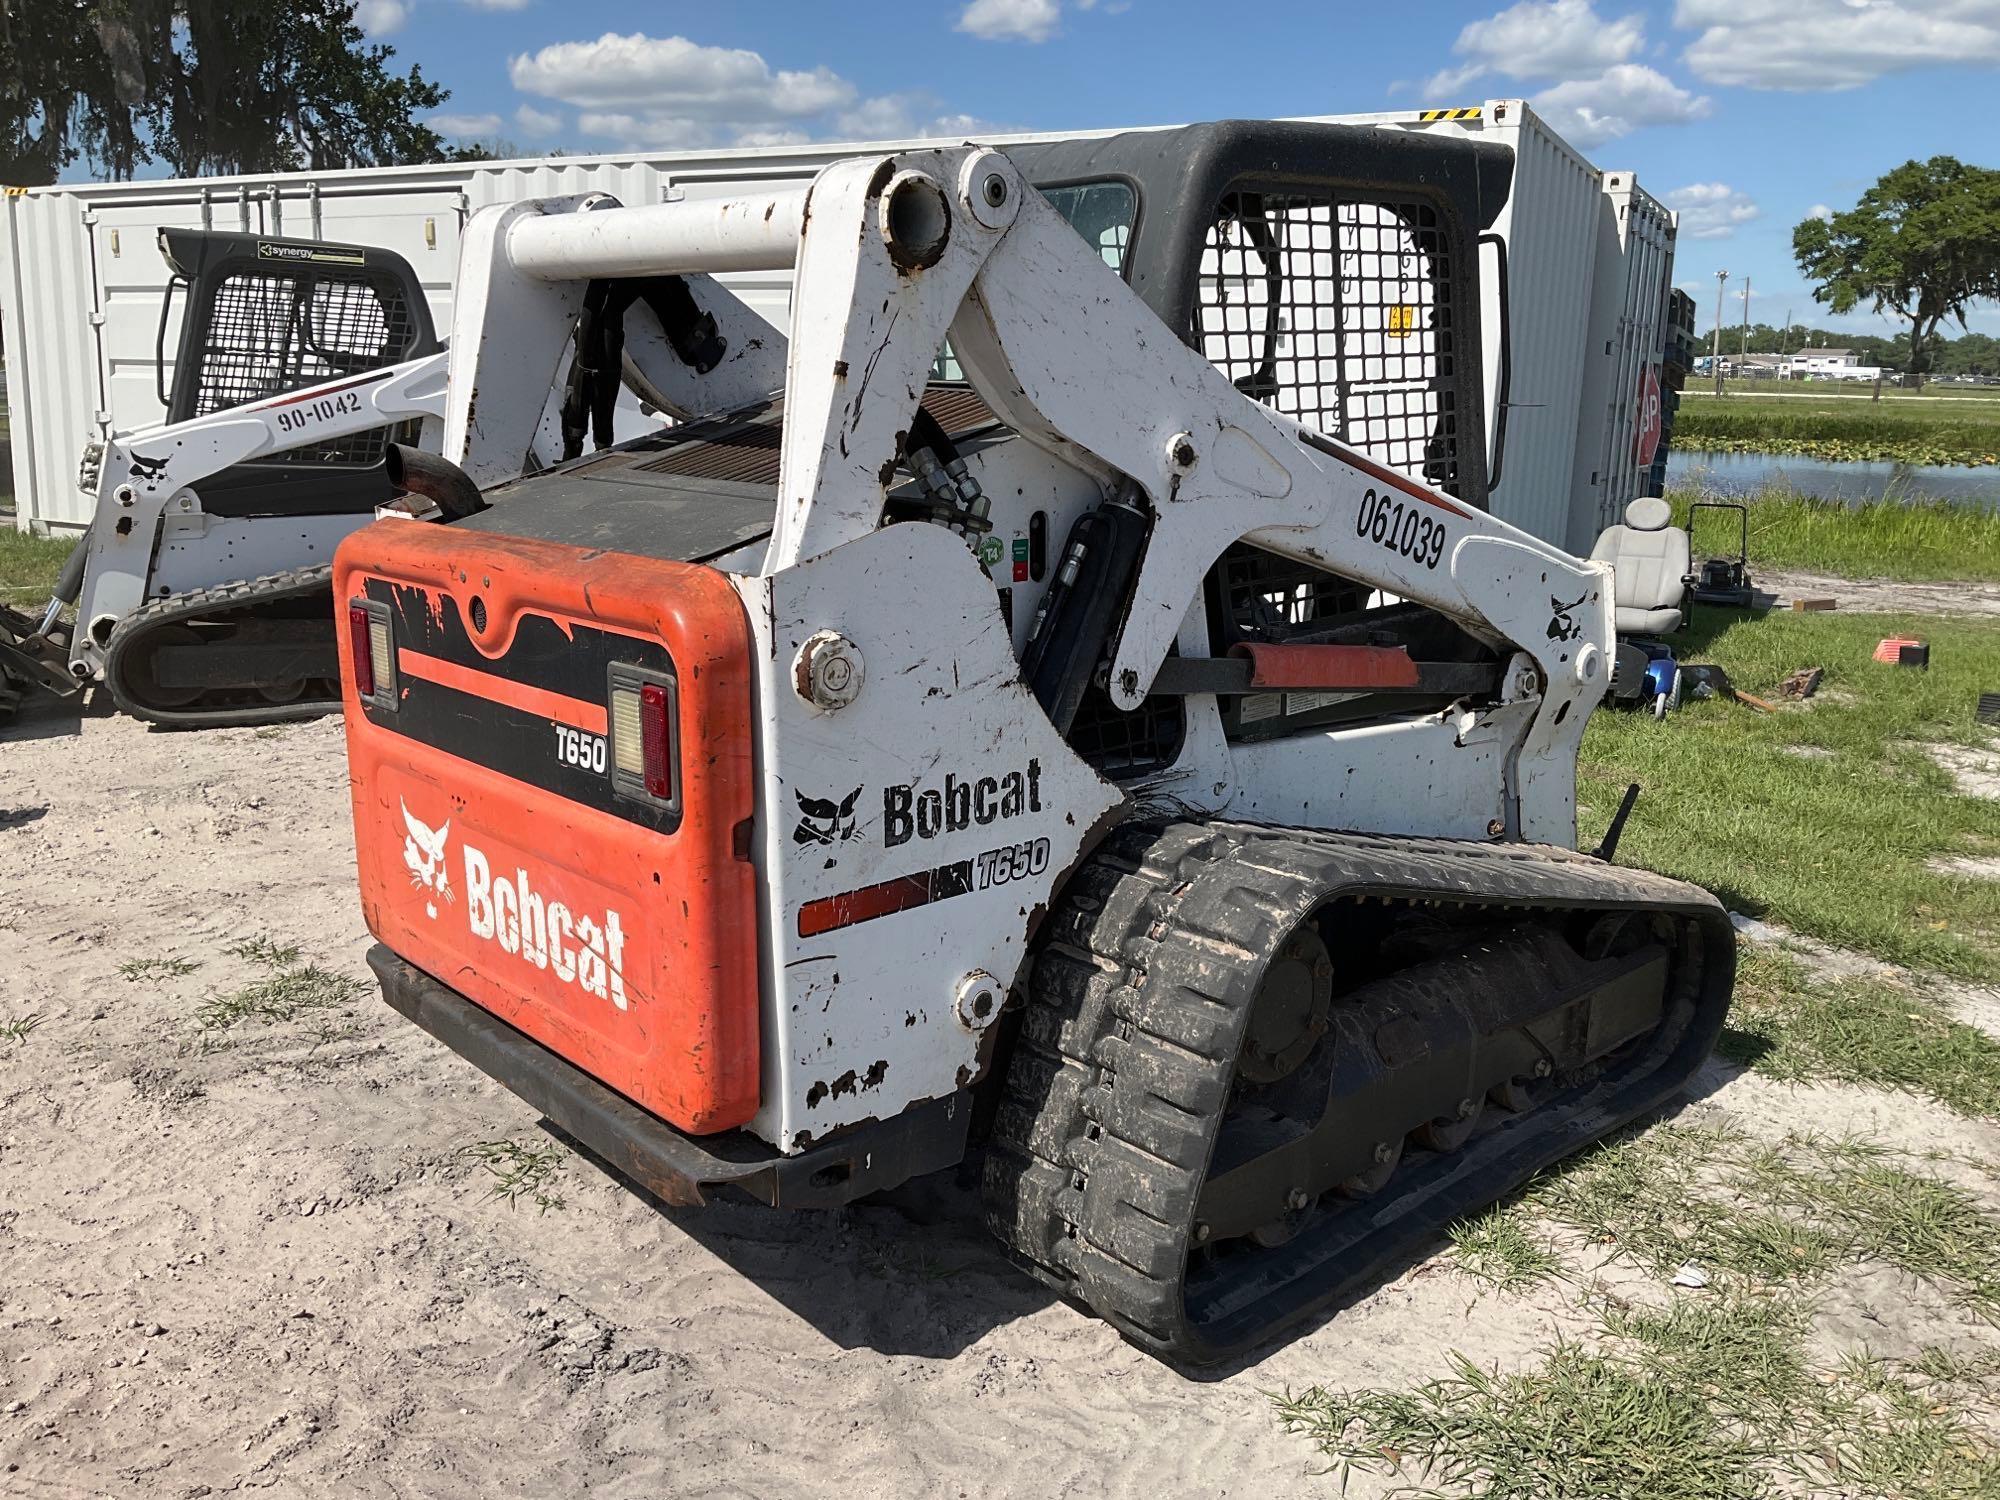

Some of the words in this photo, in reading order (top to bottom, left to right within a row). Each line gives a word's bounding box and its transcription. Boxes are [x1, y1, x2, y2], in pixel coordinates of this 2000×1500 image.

[272, 246, 313, 259] synergy
[277, 392, 362, 432] 90-1042
[985, 546, 999, 561] T4
[1356, 488, 1446, 569] 061039
[556, 725, 606, 773] T650
[883, 757, 1042, 848] Bobcat
[977, 837, 1051, 891] T650
[463, 844, 628, 1011] Bobcat
